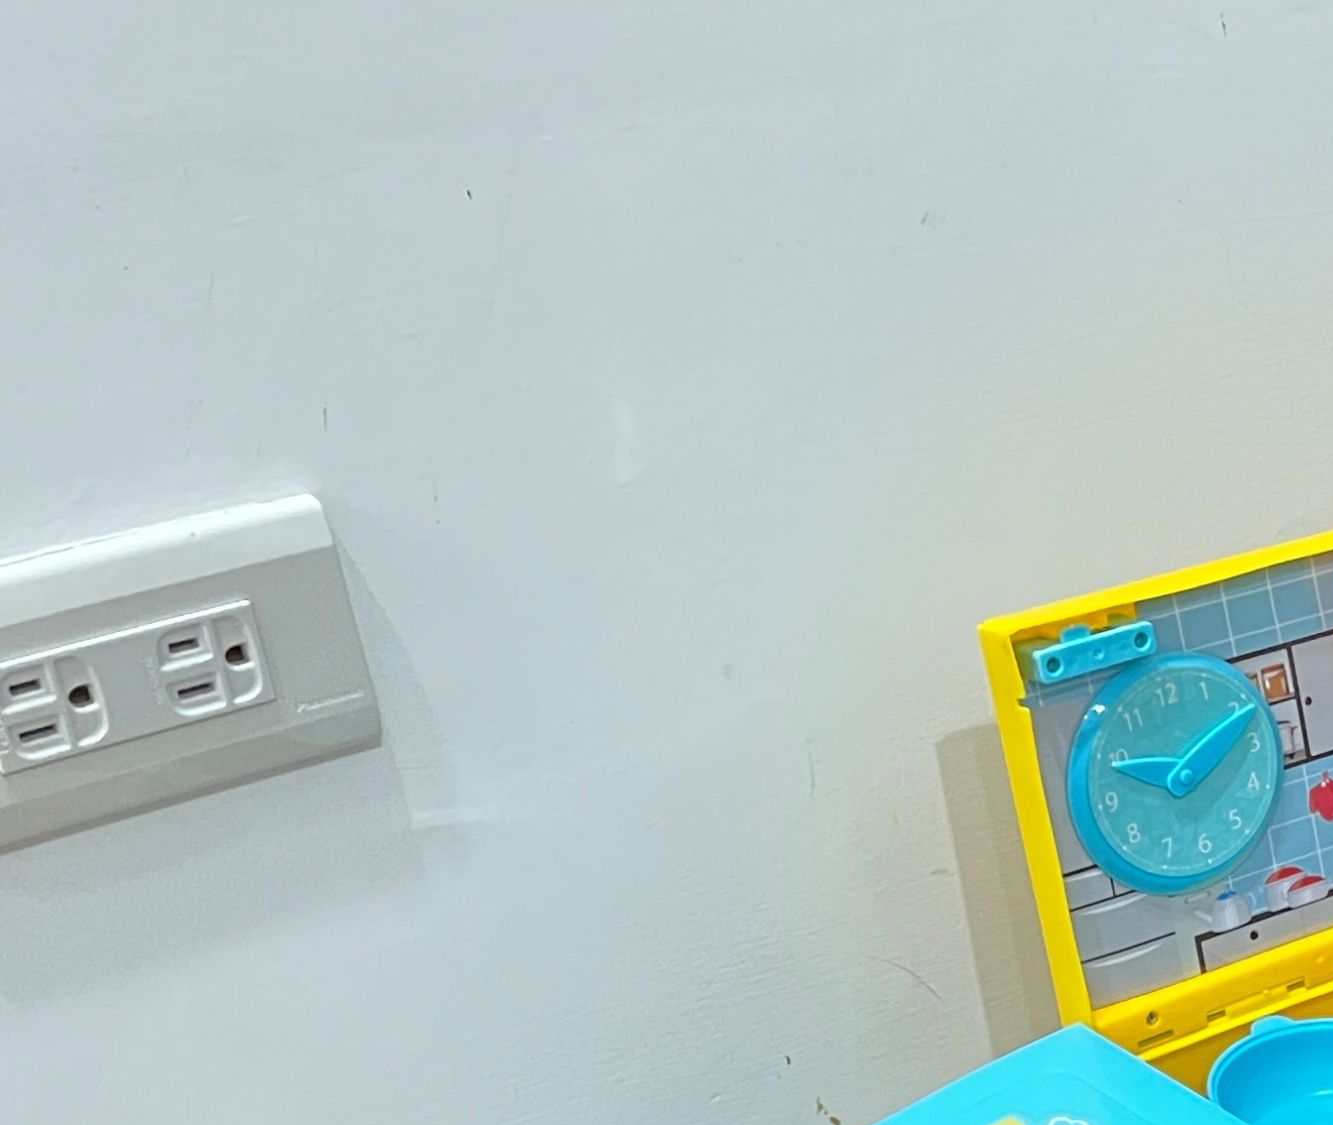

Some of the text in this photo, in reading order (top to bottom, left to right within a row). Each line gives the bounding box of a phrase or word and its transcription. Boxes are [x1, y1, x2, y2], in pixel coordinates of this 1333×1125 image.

[1155, 683, 1178, 706] 12
[1200, 681, 1209, 700] 1
[1123, 707, 1143, 732] 11
[1247, 732, 1260, 753] 3
[1247, 772, 1260, 791] 4
[1105, 791, 1119, 812] 9
[1229, 809, 1242, 830] 5
[1127, 823, 1141, 844] 8
[1198, 834, 1212, 853] 6
[1162, 837, 1173, 859] 7
